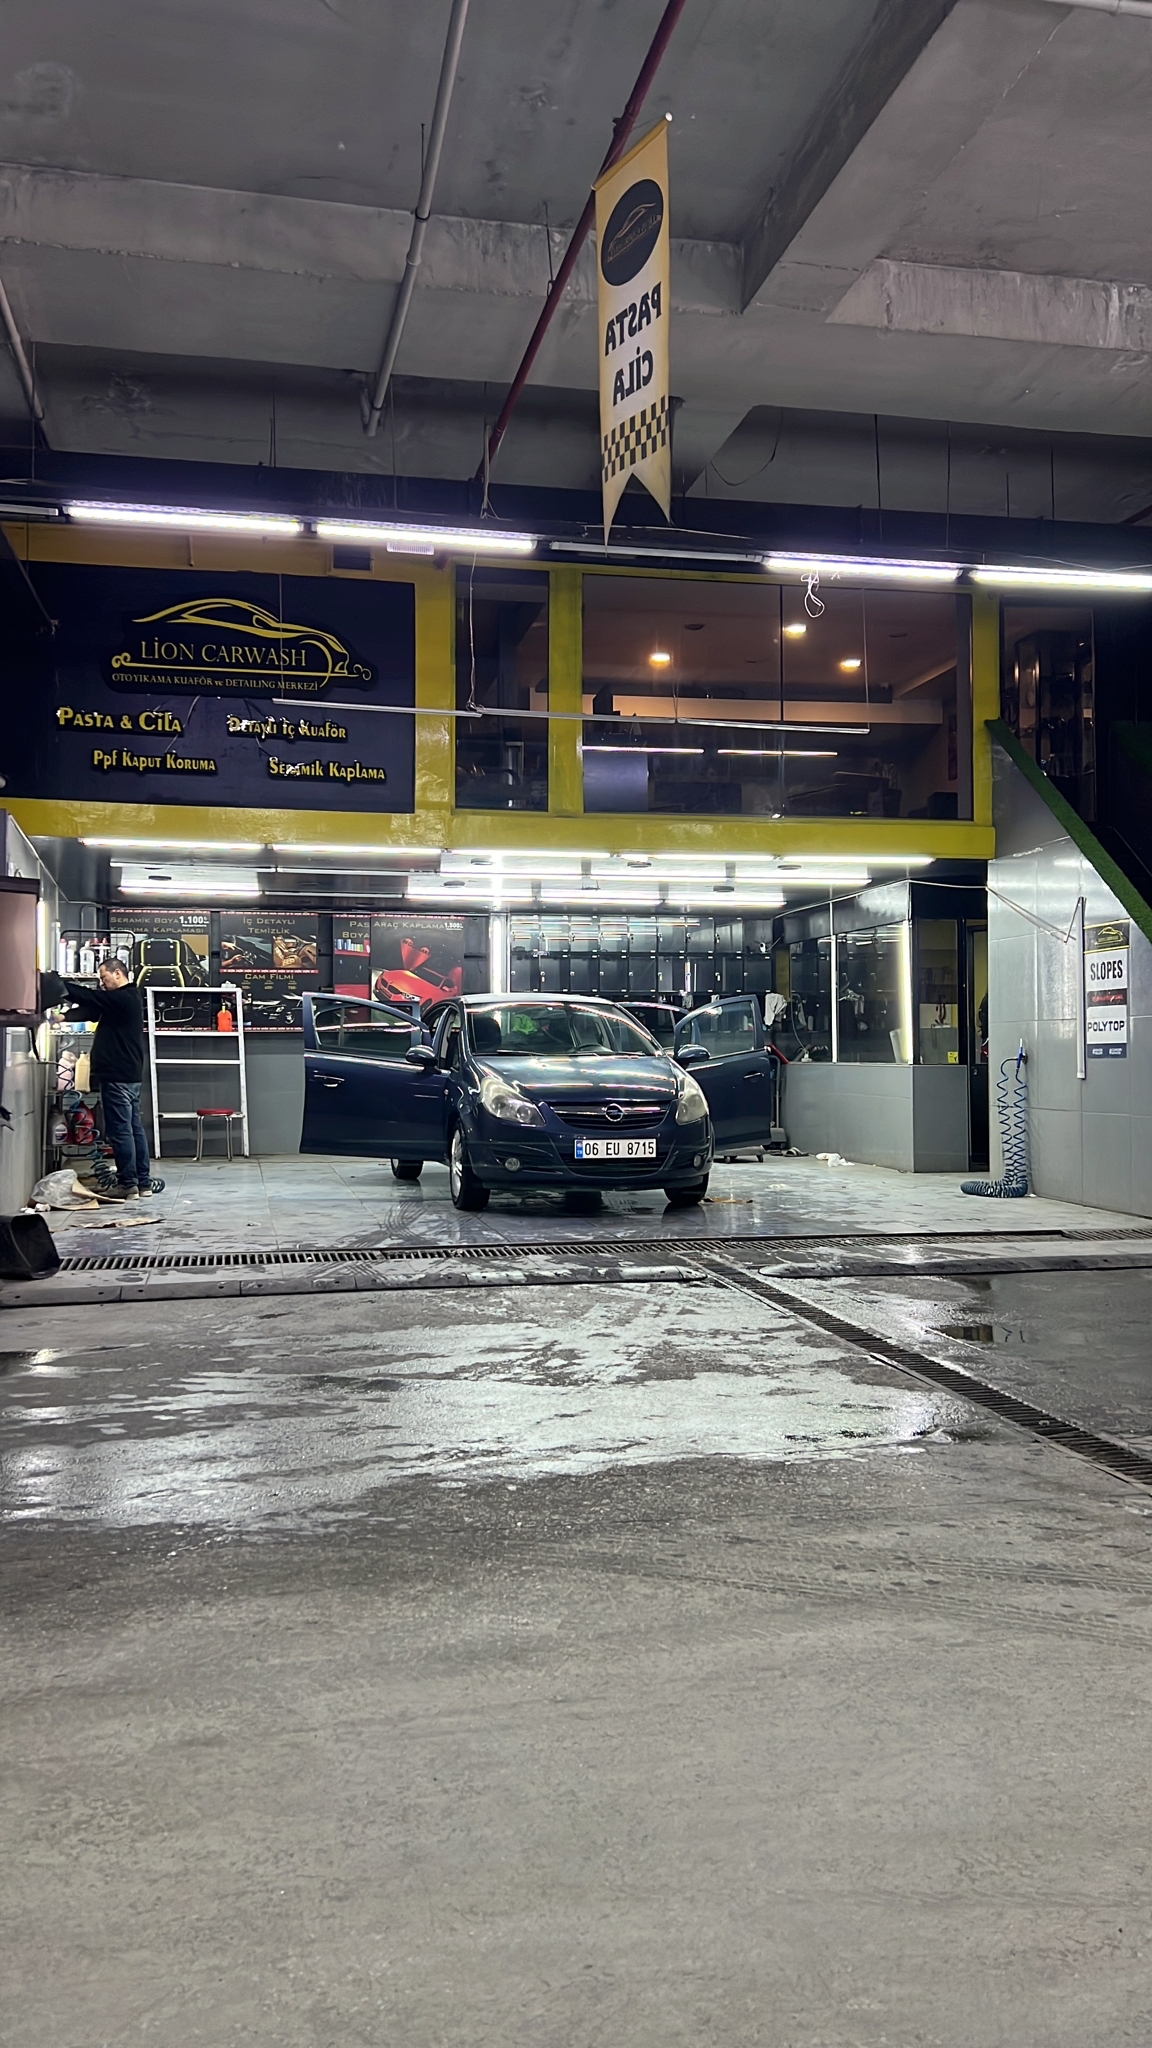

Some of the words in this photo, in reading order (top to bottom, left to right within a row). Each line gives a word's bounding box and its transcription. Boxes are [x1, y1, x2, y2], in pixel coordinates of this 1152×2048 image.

[141, 637, 194, 660] LİON
[201, 645, 306, 666] CARWASH
[112, 673, 133, 682] OTO
[133, 674, 172, 684] YIKAMA
[225, 678, 275, 689] DETAILING
[277, 680, 318, 691] MERKEZİ
[120, 715, 132, 729] &
[152, 926, 204, 934] KAPLAMASI
[373, 921, 399, 930] ARAÇ
[402, 922, 445, 930] KAPLAMA
[342, 931, 370, 939] BOYA
[1090, 960, 1123, 981] SLOPES
[1087, 1021, 1125, 1032] POLYTOP
[585, 1142, 599, 1156] 06
[605, 1142, 620, 1156] EU
[627, 1142, 654, 1155] 8715
